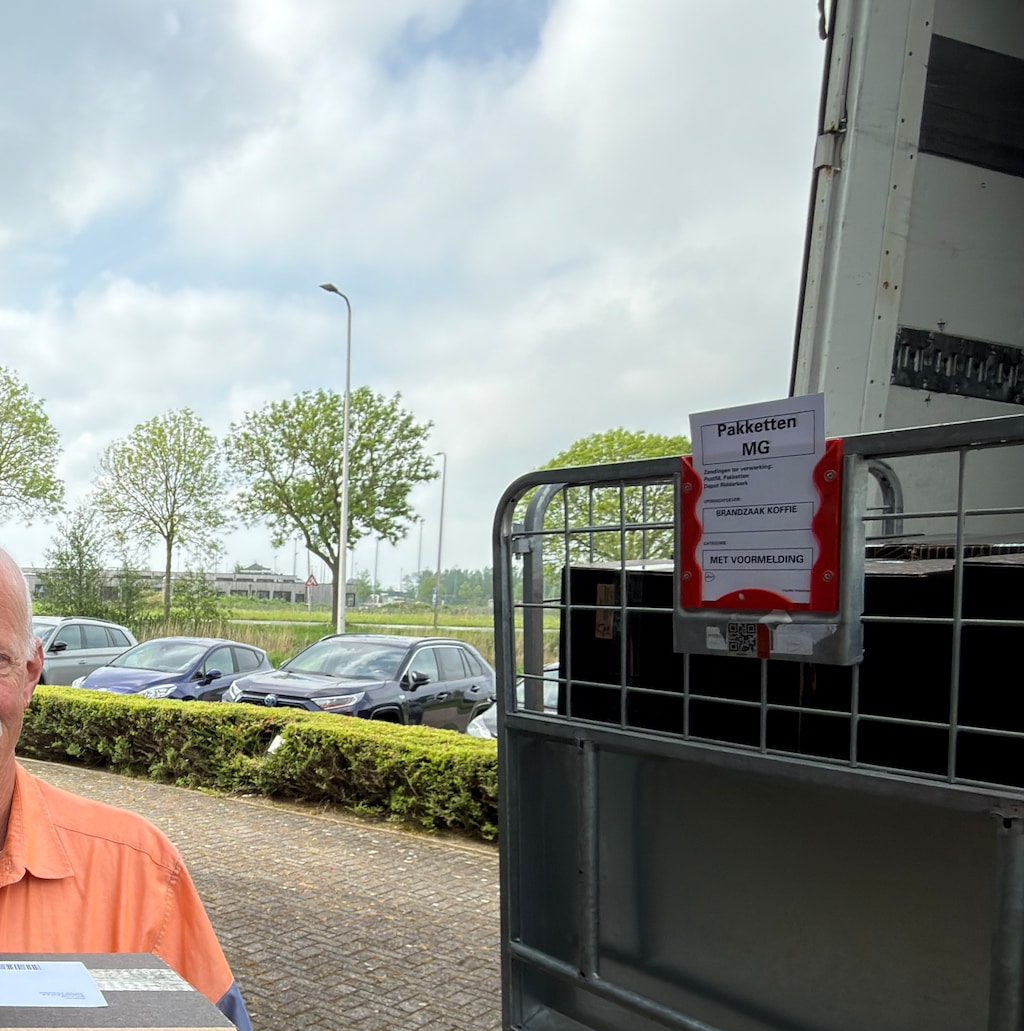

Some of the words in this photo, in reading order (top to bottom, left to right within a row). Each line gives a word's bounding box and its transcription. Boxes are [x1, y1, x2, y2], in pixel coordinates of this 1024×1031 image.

[718, 417, 796, 437] Pakketten
[742, 440, 770, 456] MG
[716, 507, 765, 517] BRANDZAAK
[767, 505, 797, 514] KOFFIE
[710, 556, 729, 564] MET
[731, 555, 804, 564] VOORMELDING
